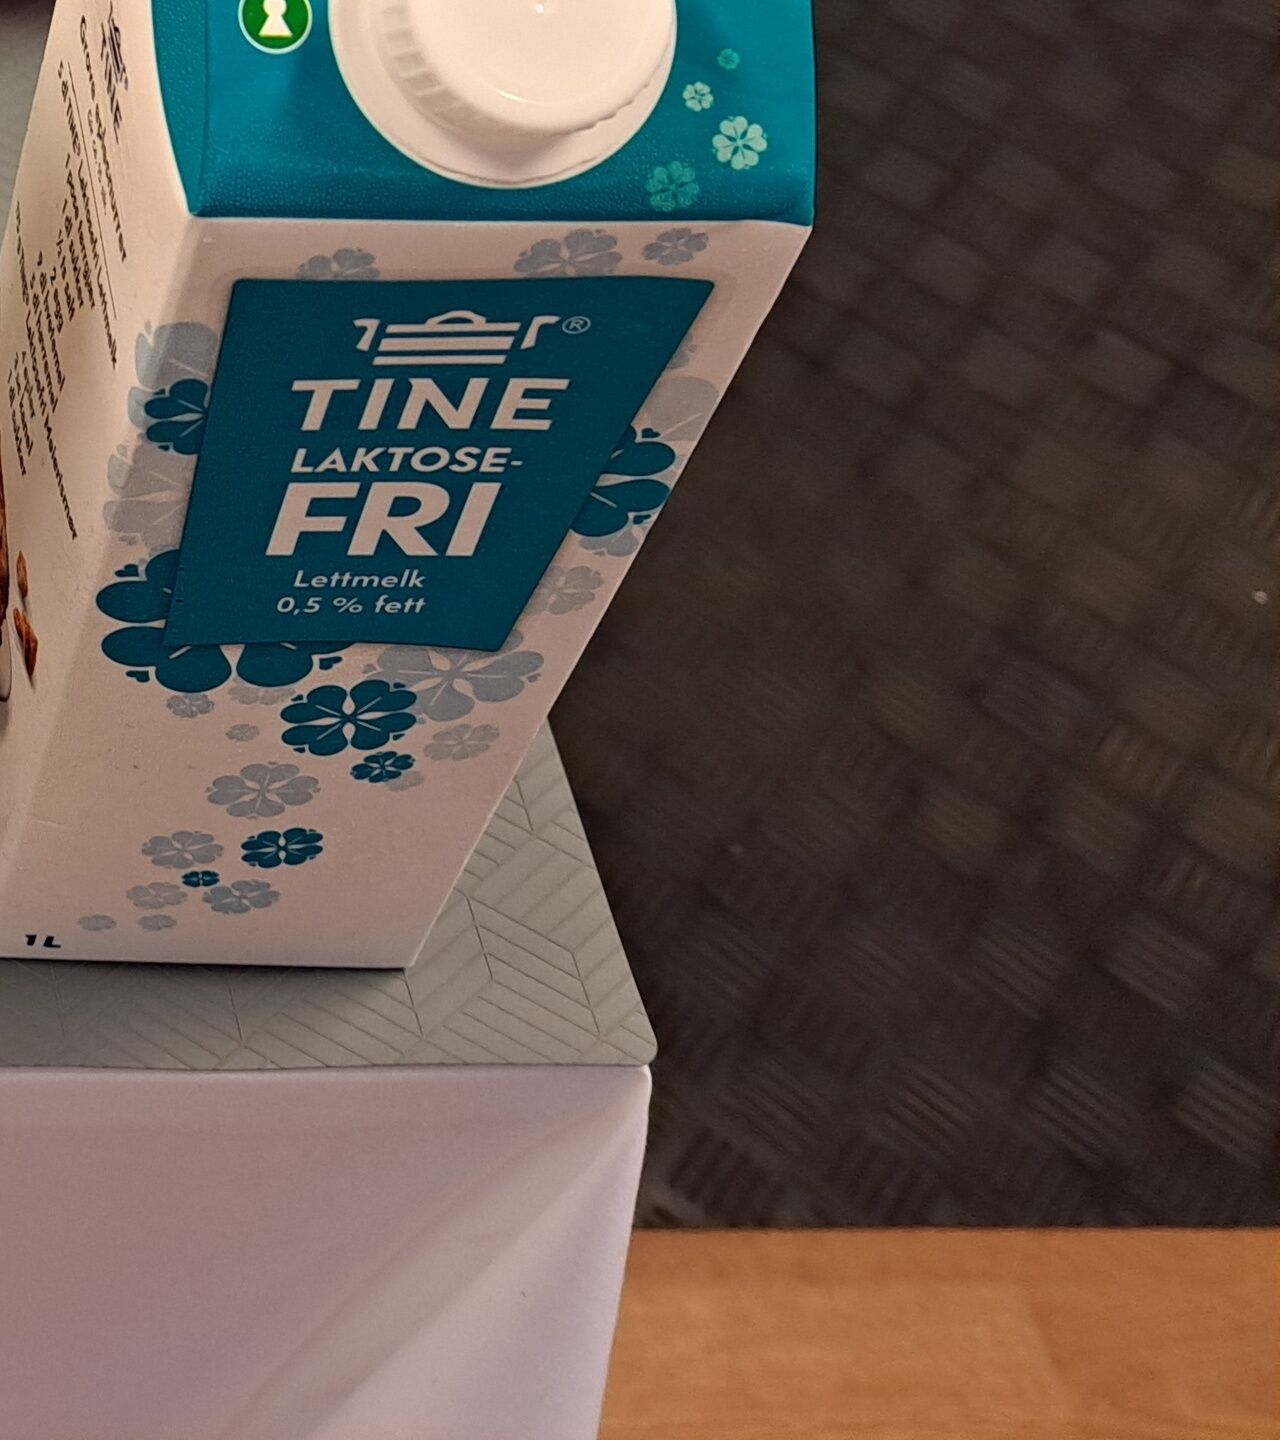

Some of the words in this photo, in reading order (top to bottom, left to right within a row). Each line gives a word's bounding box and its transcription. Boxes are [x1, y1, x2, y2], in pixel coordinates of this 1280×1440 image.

[53, 287, 64, 334] egg
[291, 378, 570, 431] TINE
[290, 447, 523, 473] LAKTOSE-
[265, 482, 502, 557] FRI
[294, 570, 426, 590] Lettmelk
[276, 596, 322, 617] 0,5
[332, 596, 364, 615] %
[373, 595, 427, 615] fett
